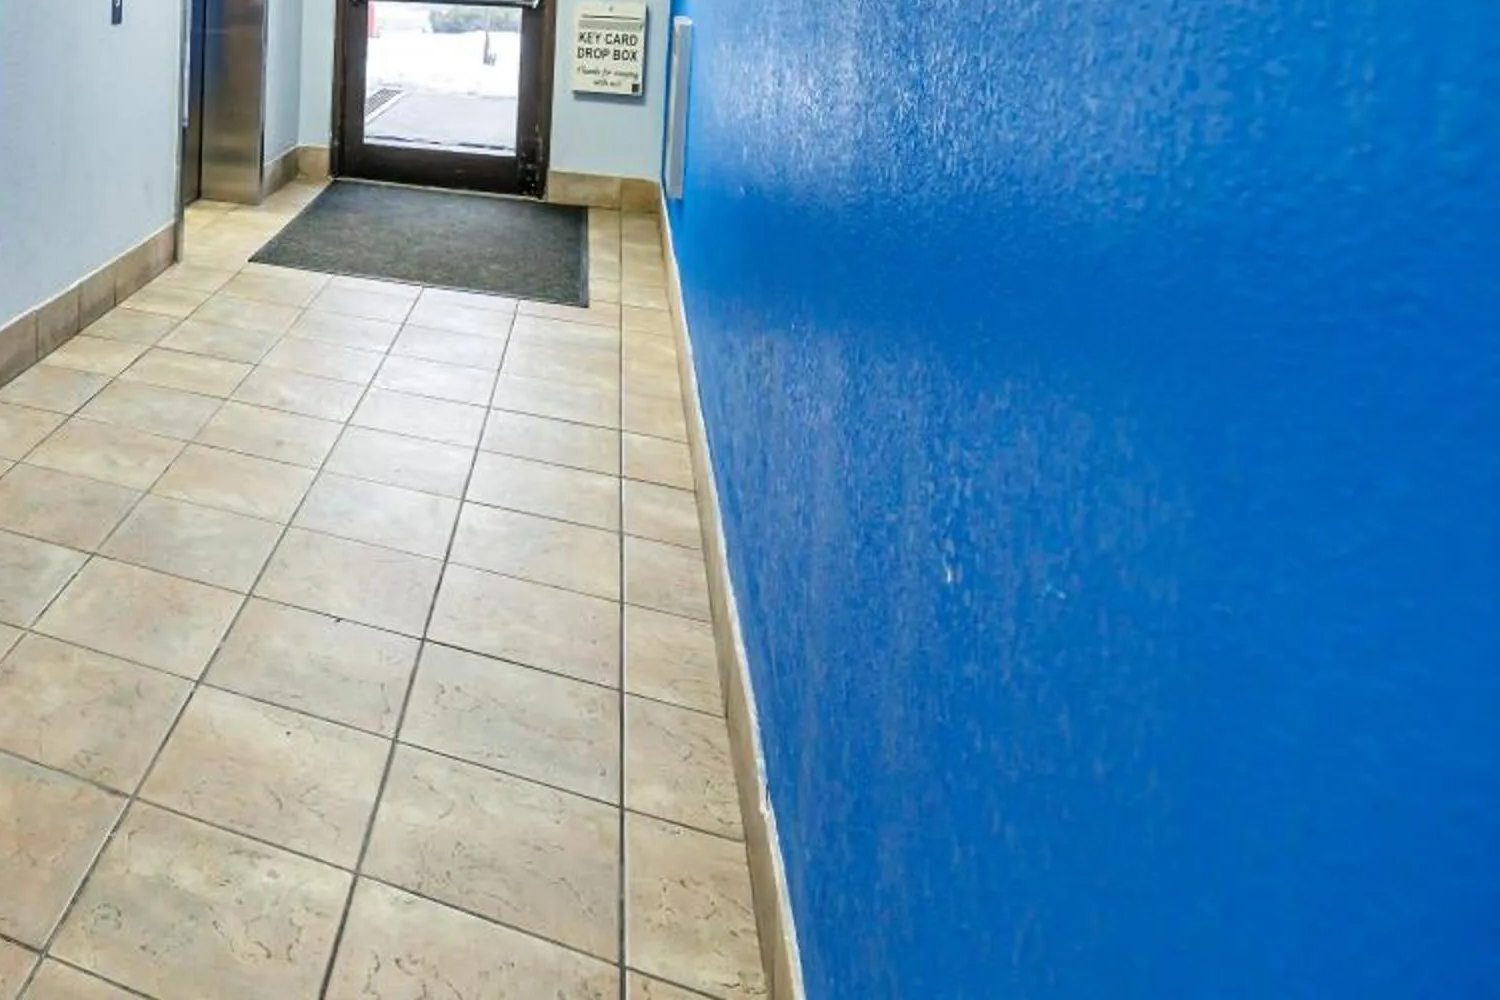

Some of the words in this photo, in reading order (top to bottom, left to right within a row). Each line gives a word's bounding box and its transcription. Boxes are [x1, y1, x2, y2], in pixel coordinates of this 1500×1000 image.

[578, 31, 601, 44] KEY
[605, 33, 638, 46] CARD
[577, 47, 610, 60] DROP
[613, 49, 637, 61] BOX
